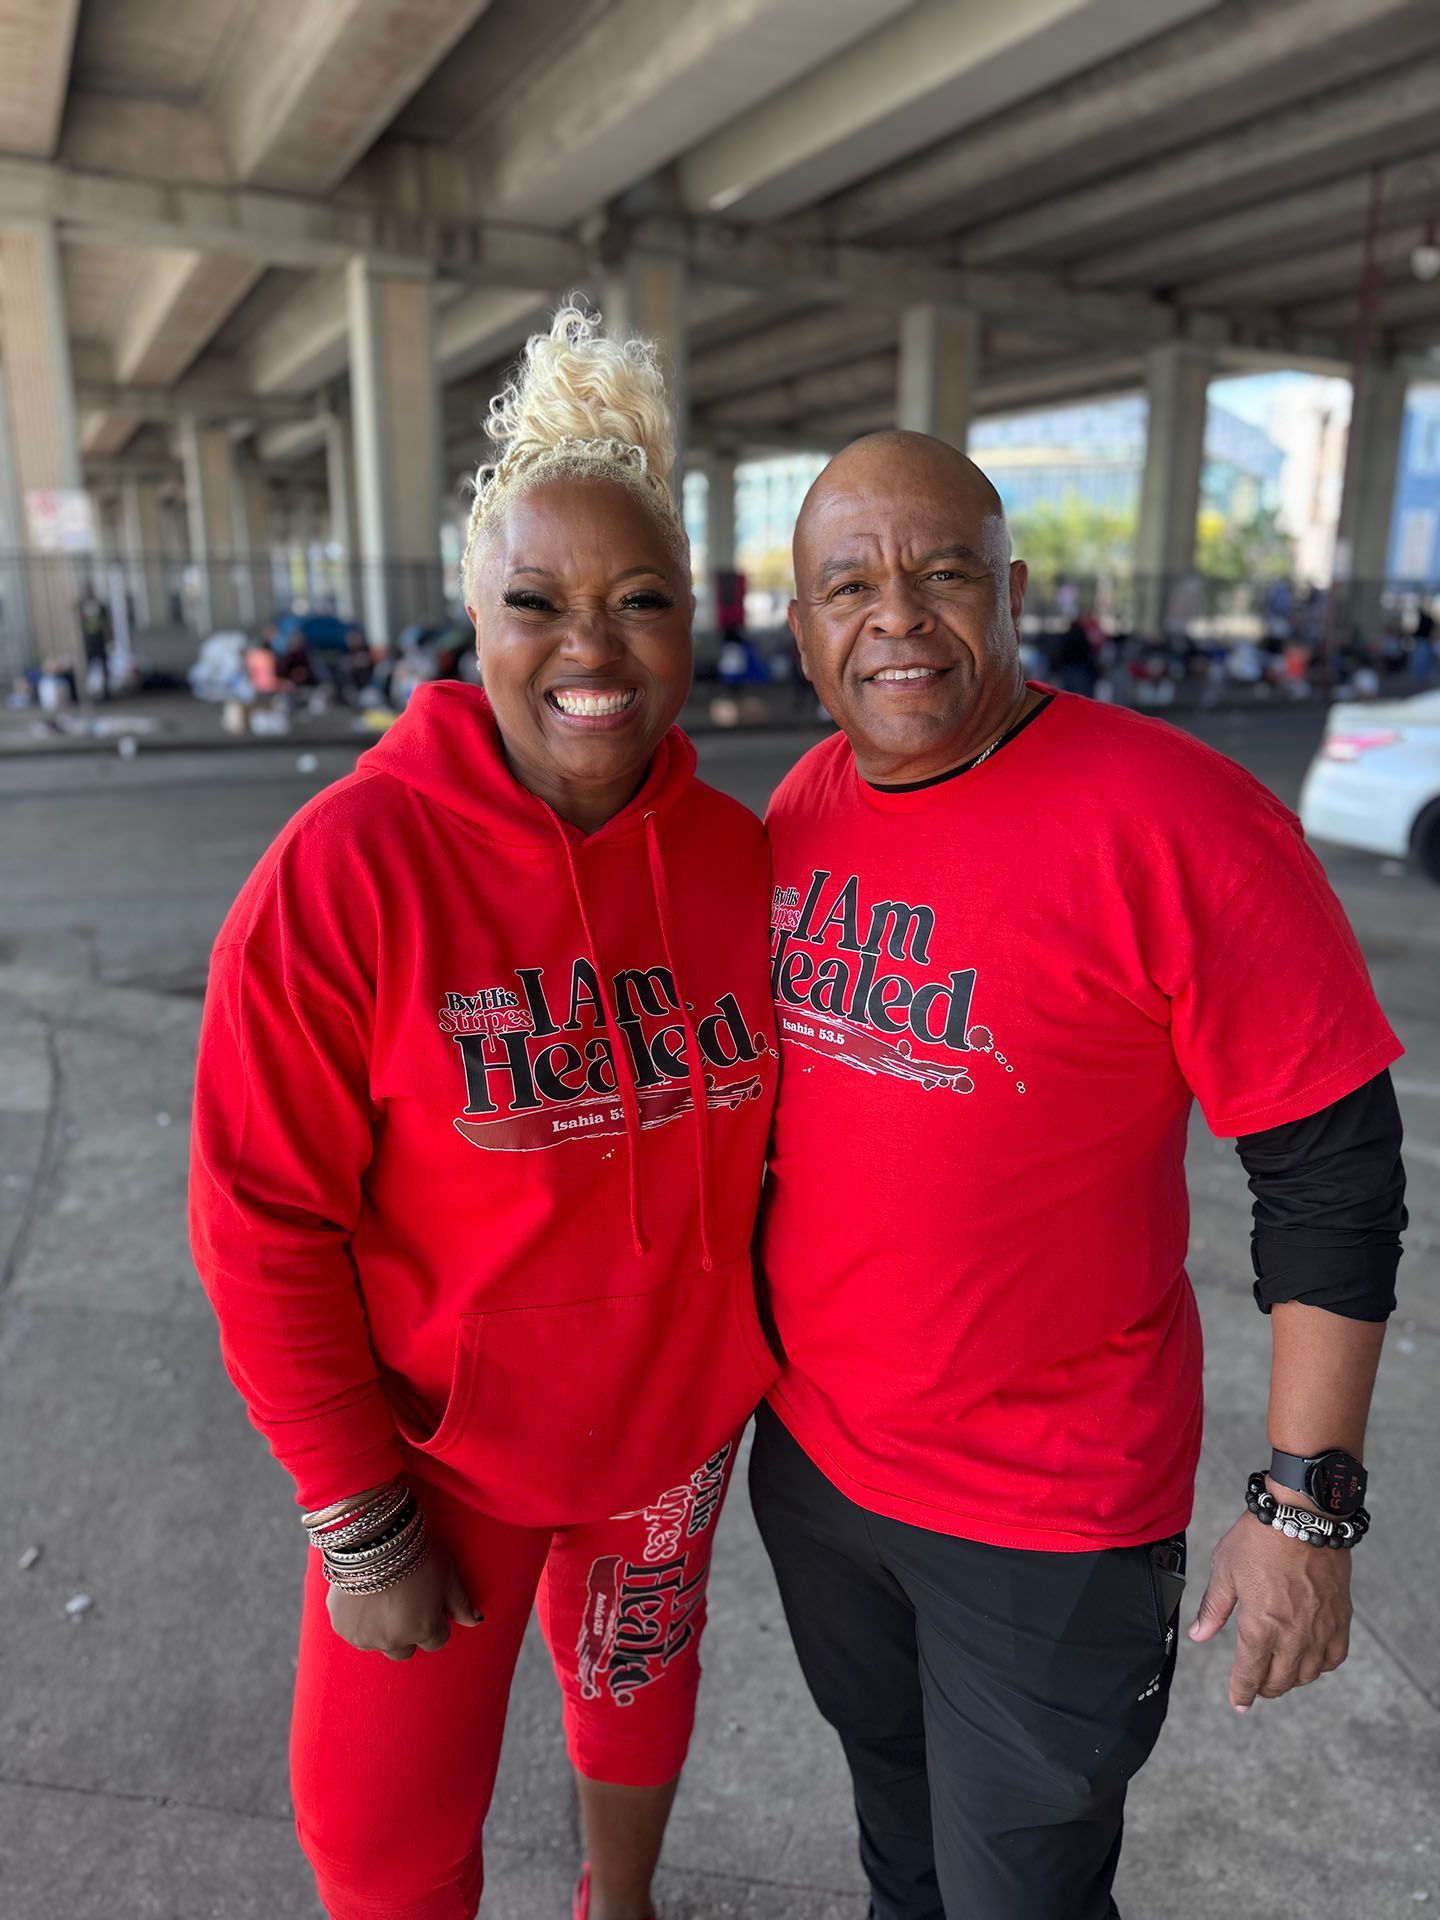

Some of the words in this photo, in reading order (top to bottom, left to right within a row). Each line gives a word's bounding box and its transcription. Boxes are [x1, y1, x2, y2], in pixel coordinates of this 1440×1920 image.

[792, 870, 831, 942] I
[810, 875, 935, 965] Am
[438, 1008, 535, 1036] Stripes
[514, 968, 560, 1038] I
[563, 957, 693, 1031] Am
[782, 1018, 815, 1037] Isahia
[818, 1028, 845, 1045] 53.5
[552, 1113, 605, 1132] Isahia
